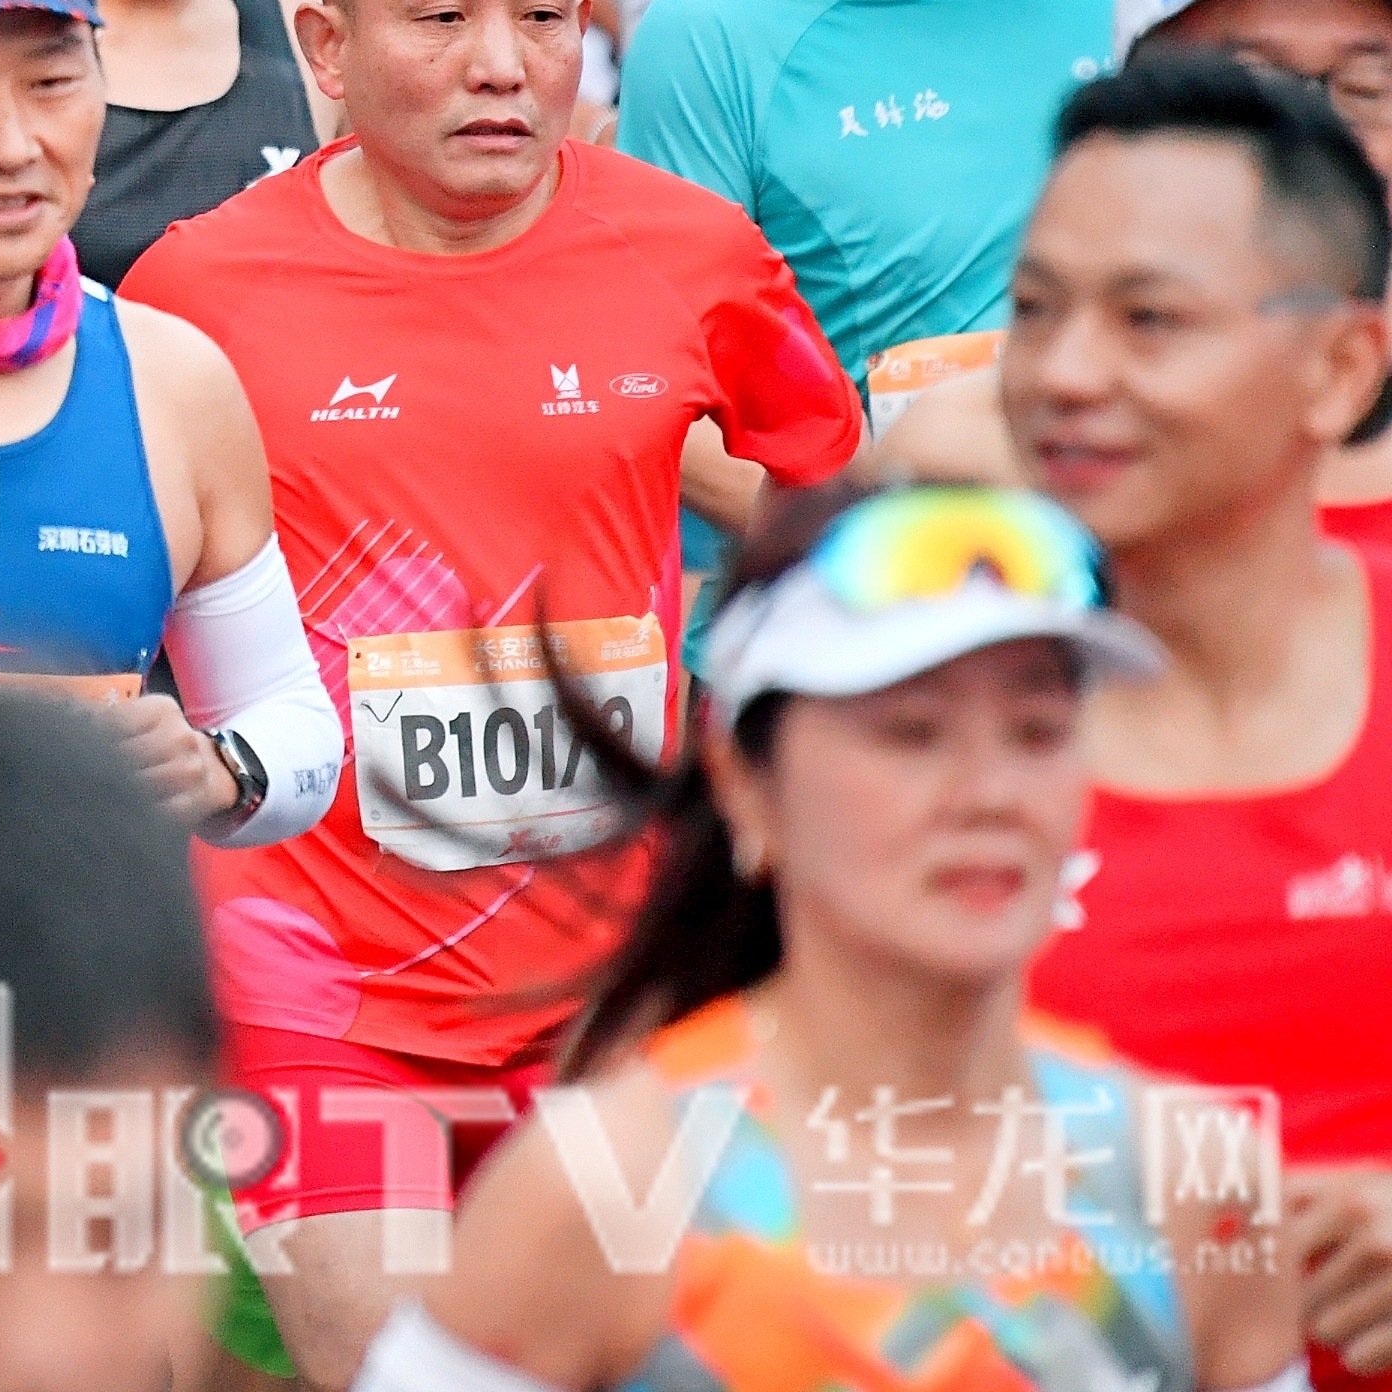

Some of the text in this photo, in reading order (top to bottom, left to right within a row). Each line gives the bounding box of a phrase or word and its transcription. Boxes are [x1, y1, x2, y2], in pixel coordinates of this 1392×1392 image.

[621, 376, 659, 395] Ford
[310, 406, 400, 422] HEALTH
[474, 654, 569, 674] CHANGN
